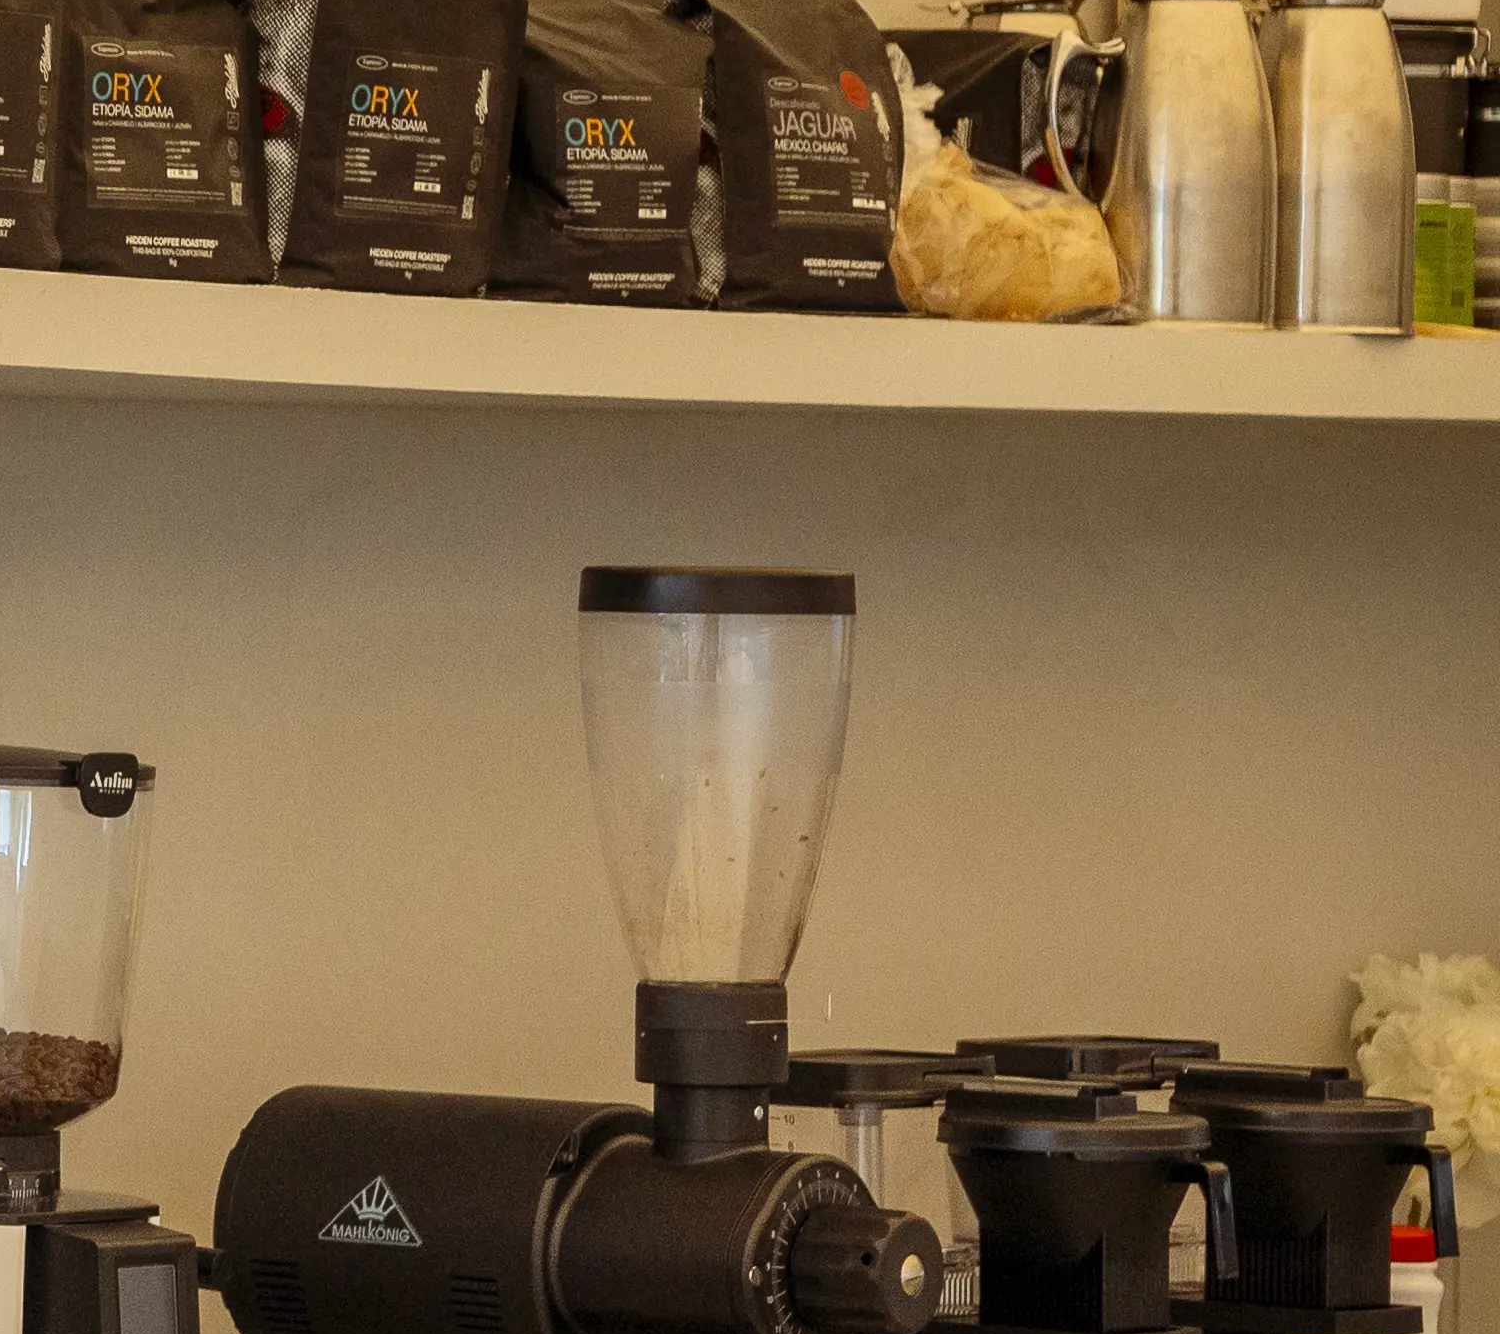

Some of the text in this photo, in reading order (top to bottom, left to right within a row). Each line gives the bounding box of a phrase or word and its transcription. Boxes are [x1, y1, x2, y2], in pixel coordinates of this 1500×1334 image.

[92, 72, 162, 104] ORYX
[351, 83, 418, 117] ORYX
[134, 105, 175, 120] SIDAMA
[391, 117, 428, 133] SIDAMA
[564, 117, 636, 147] ORYX
[773, 109, 857, 142] JAGUAR
[610, 148, 649, 162] SIDAMA
[126, 235, 152, 245] HIDDEN
[153, 236, 180, 247] COFFEE
[369, 247, 393, 258] HIDDEN
[394, 249, 417, 260] COFFEE
[784, 1114, 795, 1125] 10
[331, 1223, 410, 1243] MAHLKÖNIG
